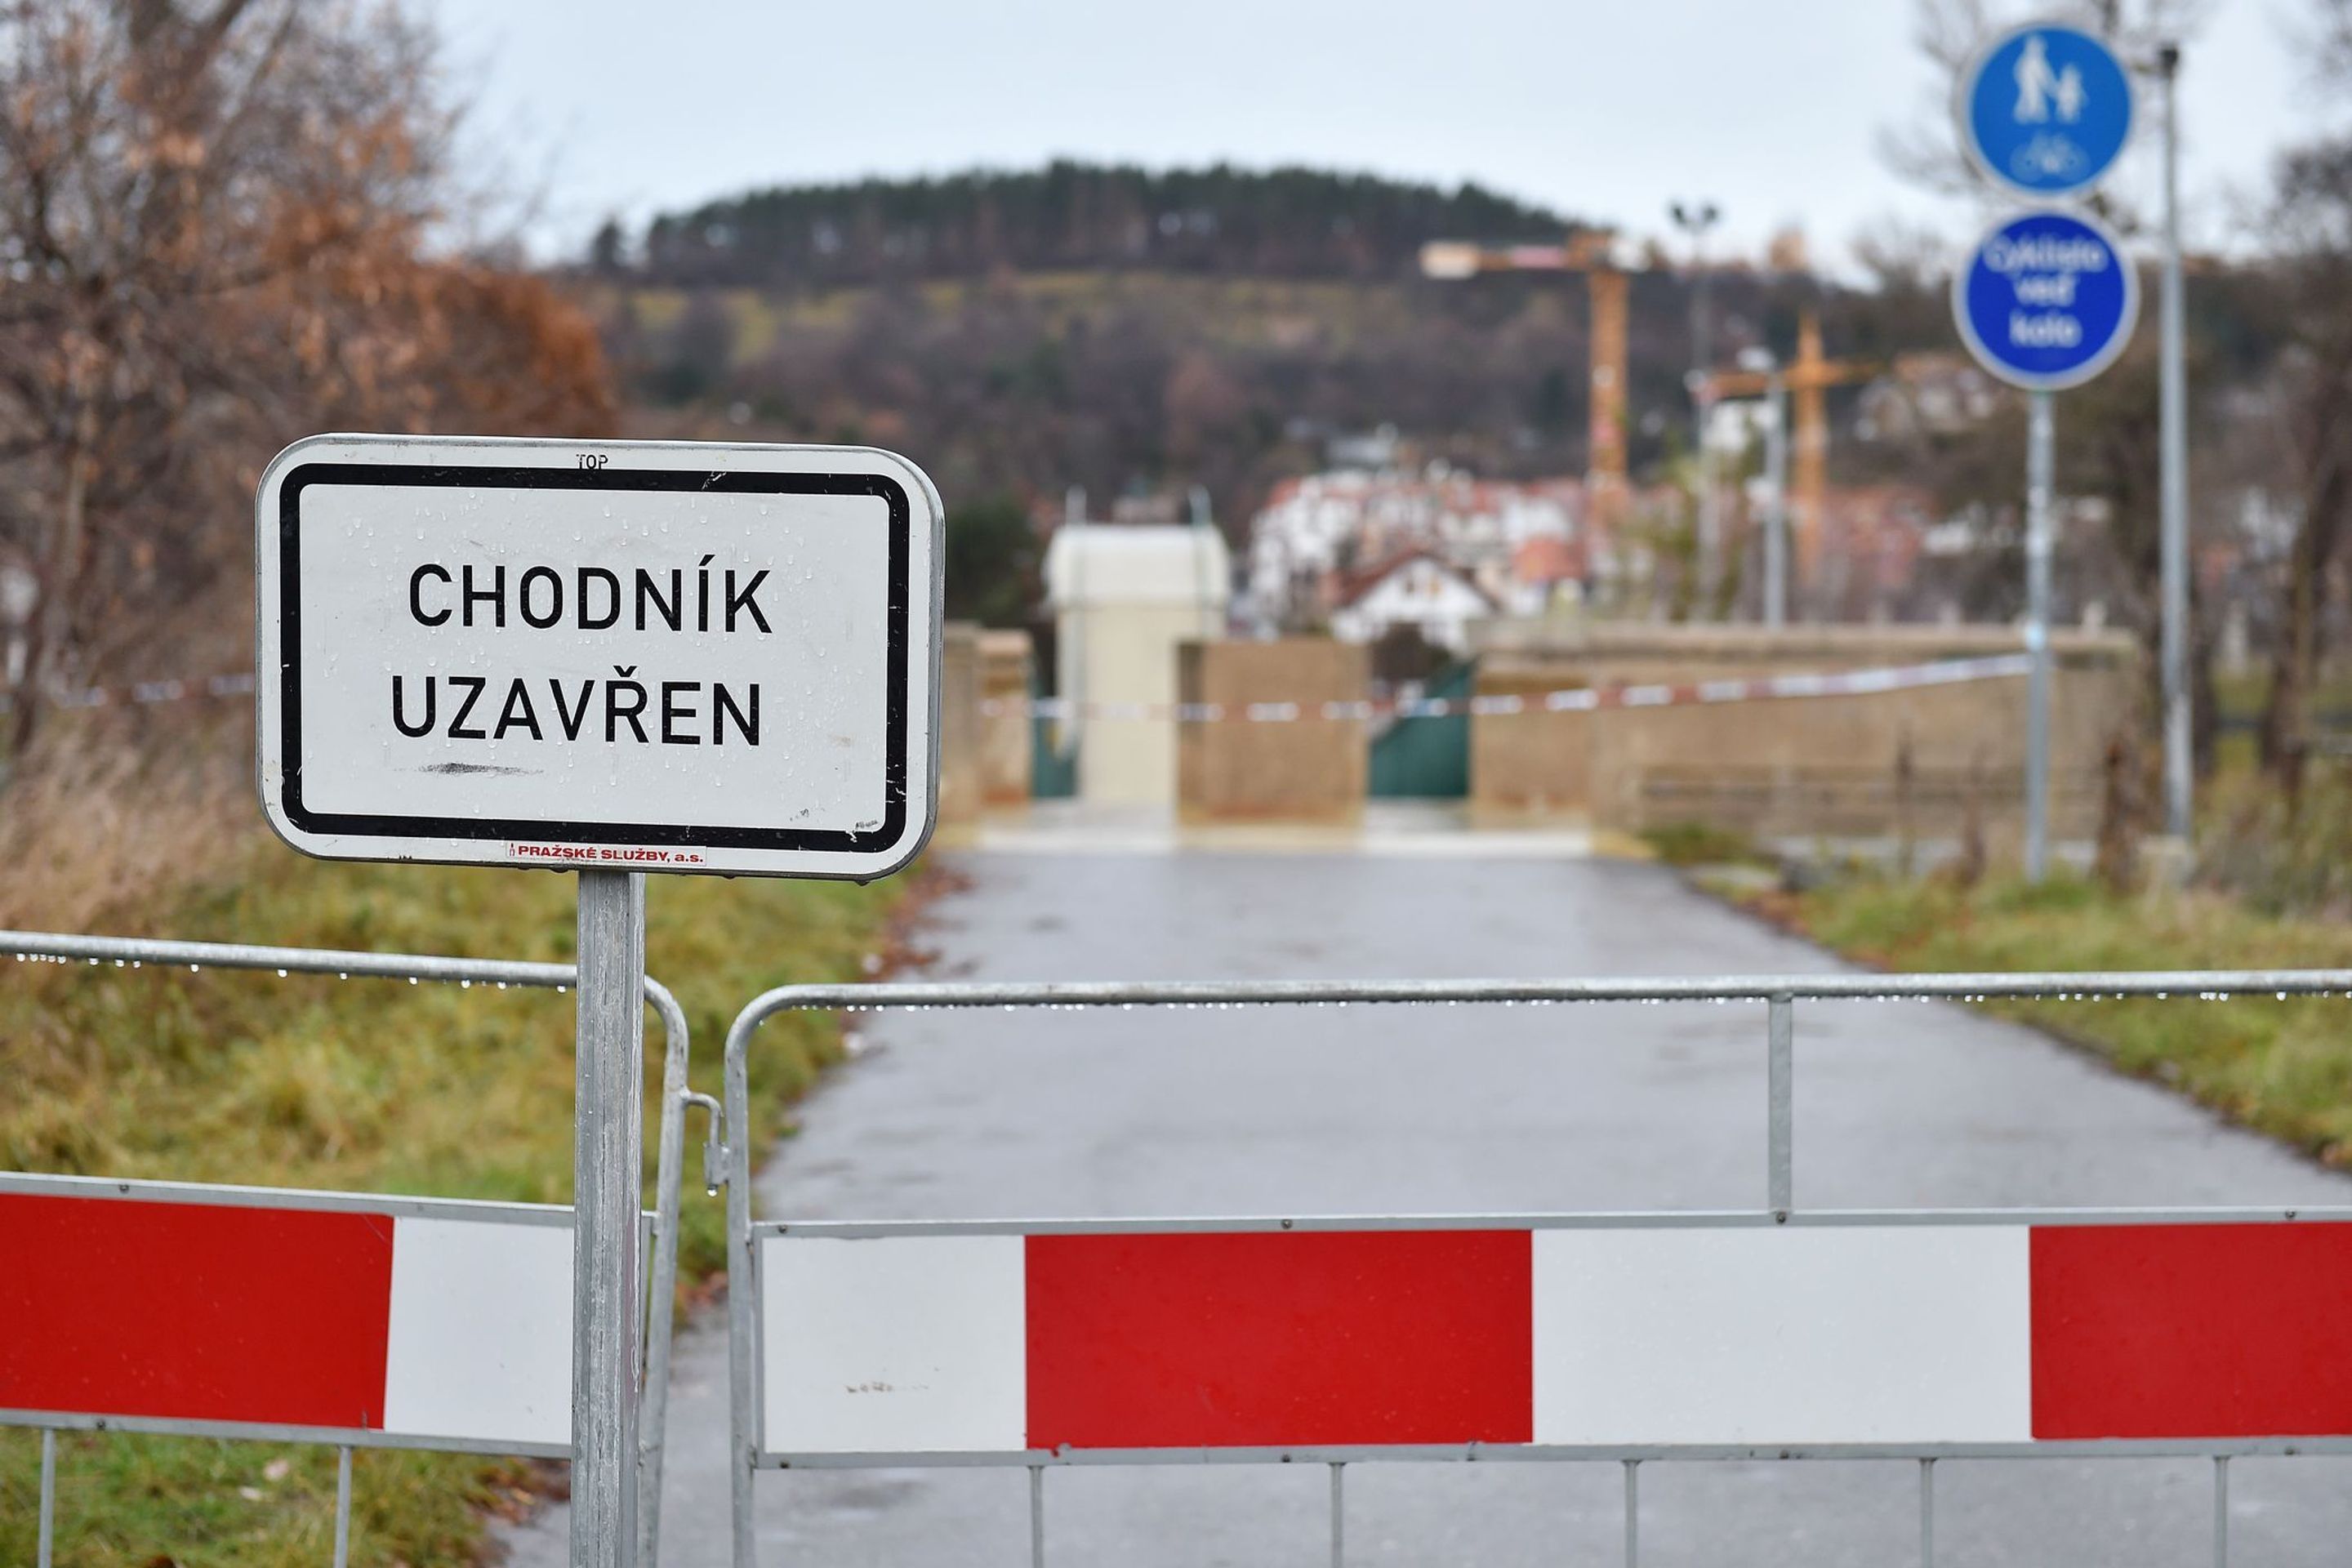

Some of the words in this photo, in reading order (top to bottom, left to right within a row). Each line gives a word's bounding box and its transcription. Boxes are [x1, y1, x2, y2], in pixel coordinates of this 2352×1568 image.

[2009, 308, 2082, 348] kolo
[576, 453, 608, 470] TOP
[409, 555, 773, 635] CHODNÍK
[391, 666, 762, 746] UZAVŘEN
[518, 844, 597, 858] PRAŽSKÉ
[600, 848, 671, 863] SLUŽBY,
[674, 853, 703, 862] a.s.
